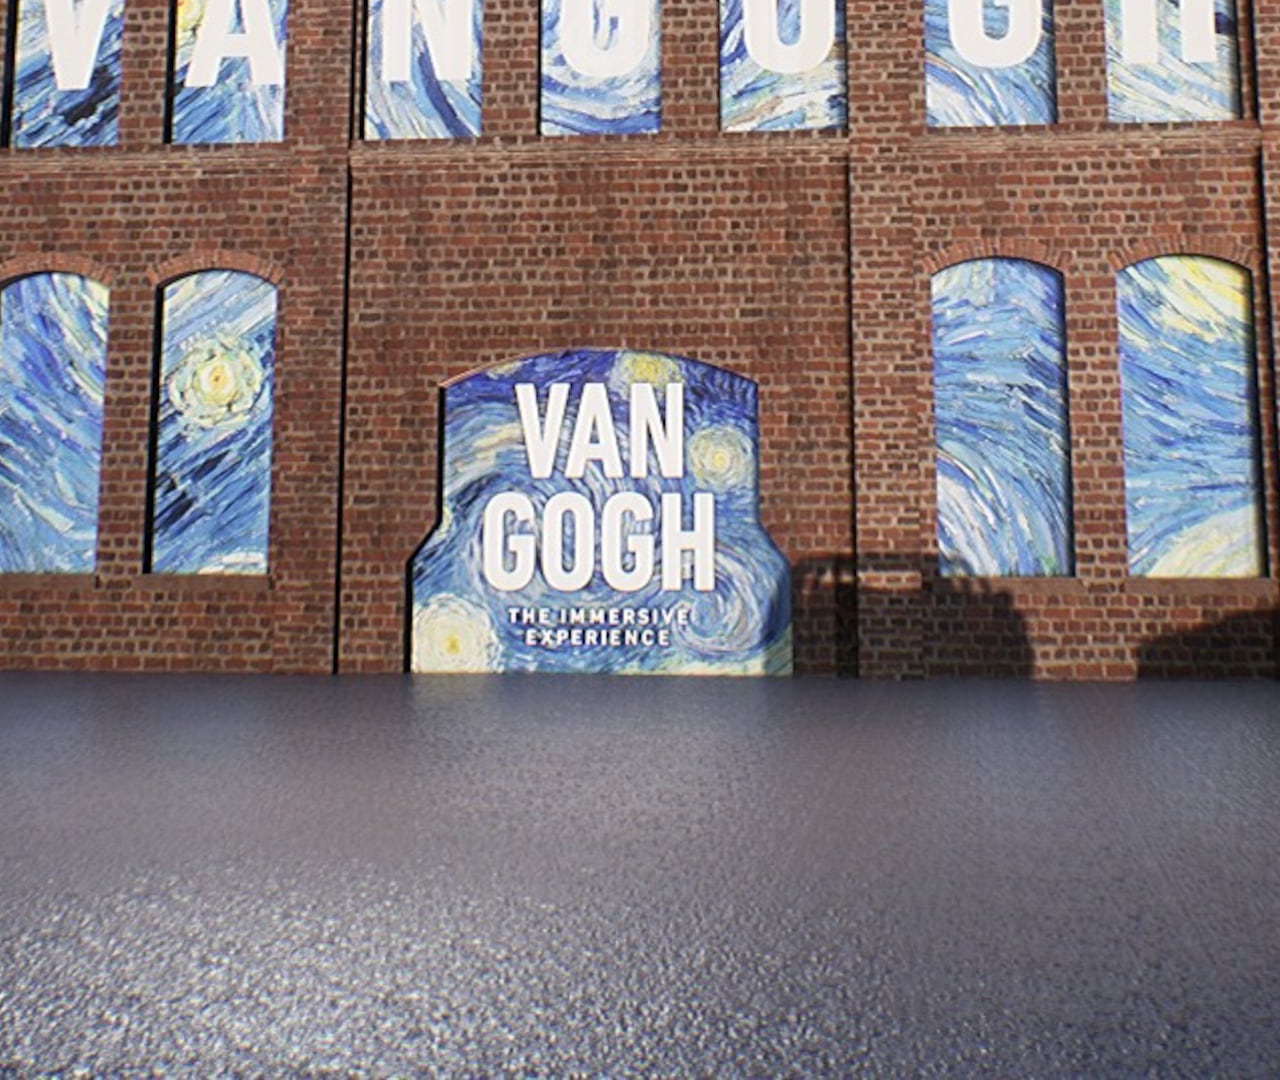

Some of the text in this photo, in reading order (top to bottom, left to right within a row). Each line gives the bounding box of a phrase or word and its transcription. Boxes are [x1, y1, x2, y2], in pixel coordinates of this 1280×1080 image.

[515, 382, 684, 479] VAN
[483, 491, 715, 592] GOGH
[509, 607, 689, 625] THE IMMERSIVE
[526, 628, 671, 647] EXPERIENCE
